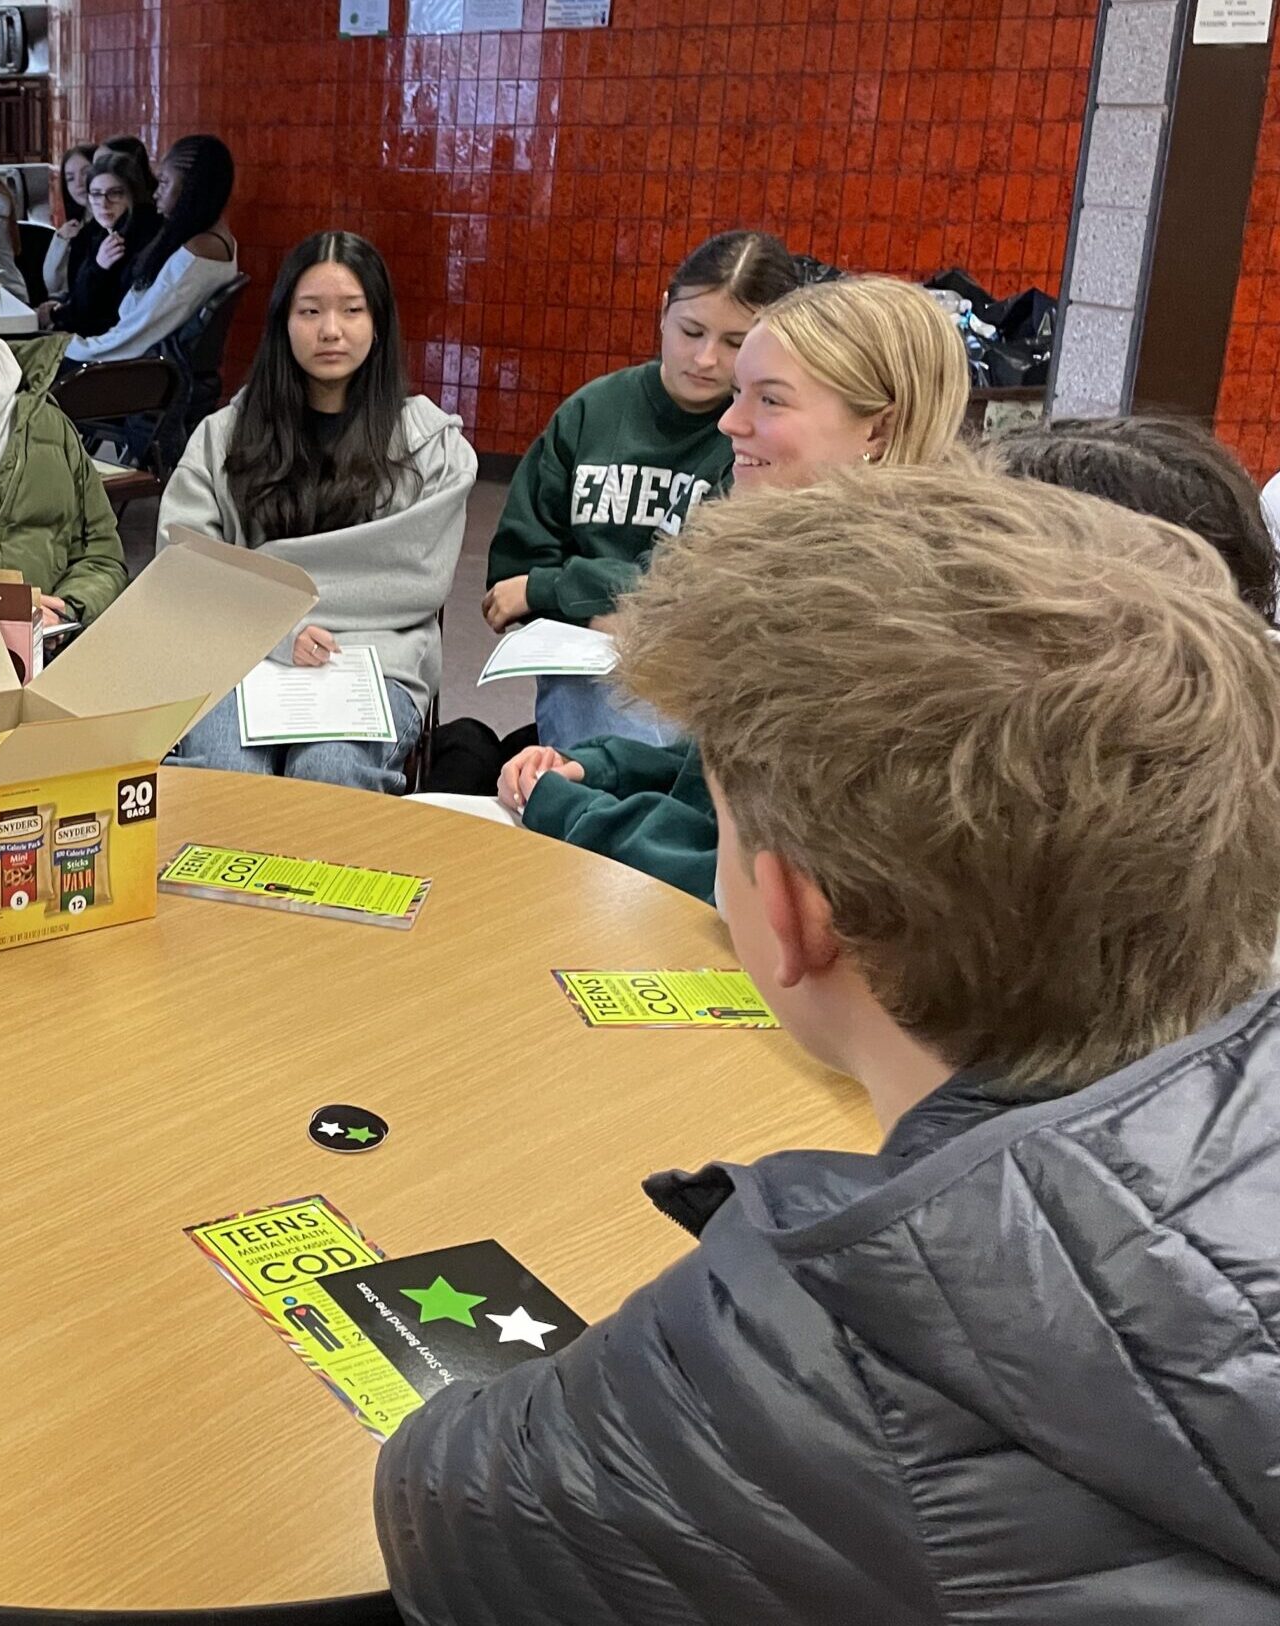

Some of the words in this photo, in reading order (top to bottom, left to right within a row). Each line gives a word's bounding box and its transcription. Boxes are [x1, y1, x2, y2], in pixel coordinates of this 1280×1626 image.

[120, 781, 153, 811] 20
[126, 805, 150, 819] BAGS
[58, 824, 97, 839] SNYDER'S
[10, 853, 28, 864] Mini
[67, 860, 89, 870] Sticks
[176, 851, 212, 877] TEENS
[16, 896, 23, 906] 8
[71, 900, 83, 910] 12
[578, 978, 622, 1016] TEENS
[238, 1240, 284, 1257] MENTAL
[246, 1247, 303, 1266] SUBSTANCE
[260, 1247, 367, 1284] COD.
[356, 1282, 379, 1303] Stars
[375, 1301, 393, 1317] the
[386, 1316, 420, 1347] Behind
[416, 1346, 441, 1369] Story
[343, 1377, 355, 1387] 1
[359, 1394, 374, 1406] 2
[375, 1410, 389, 1422] 3
